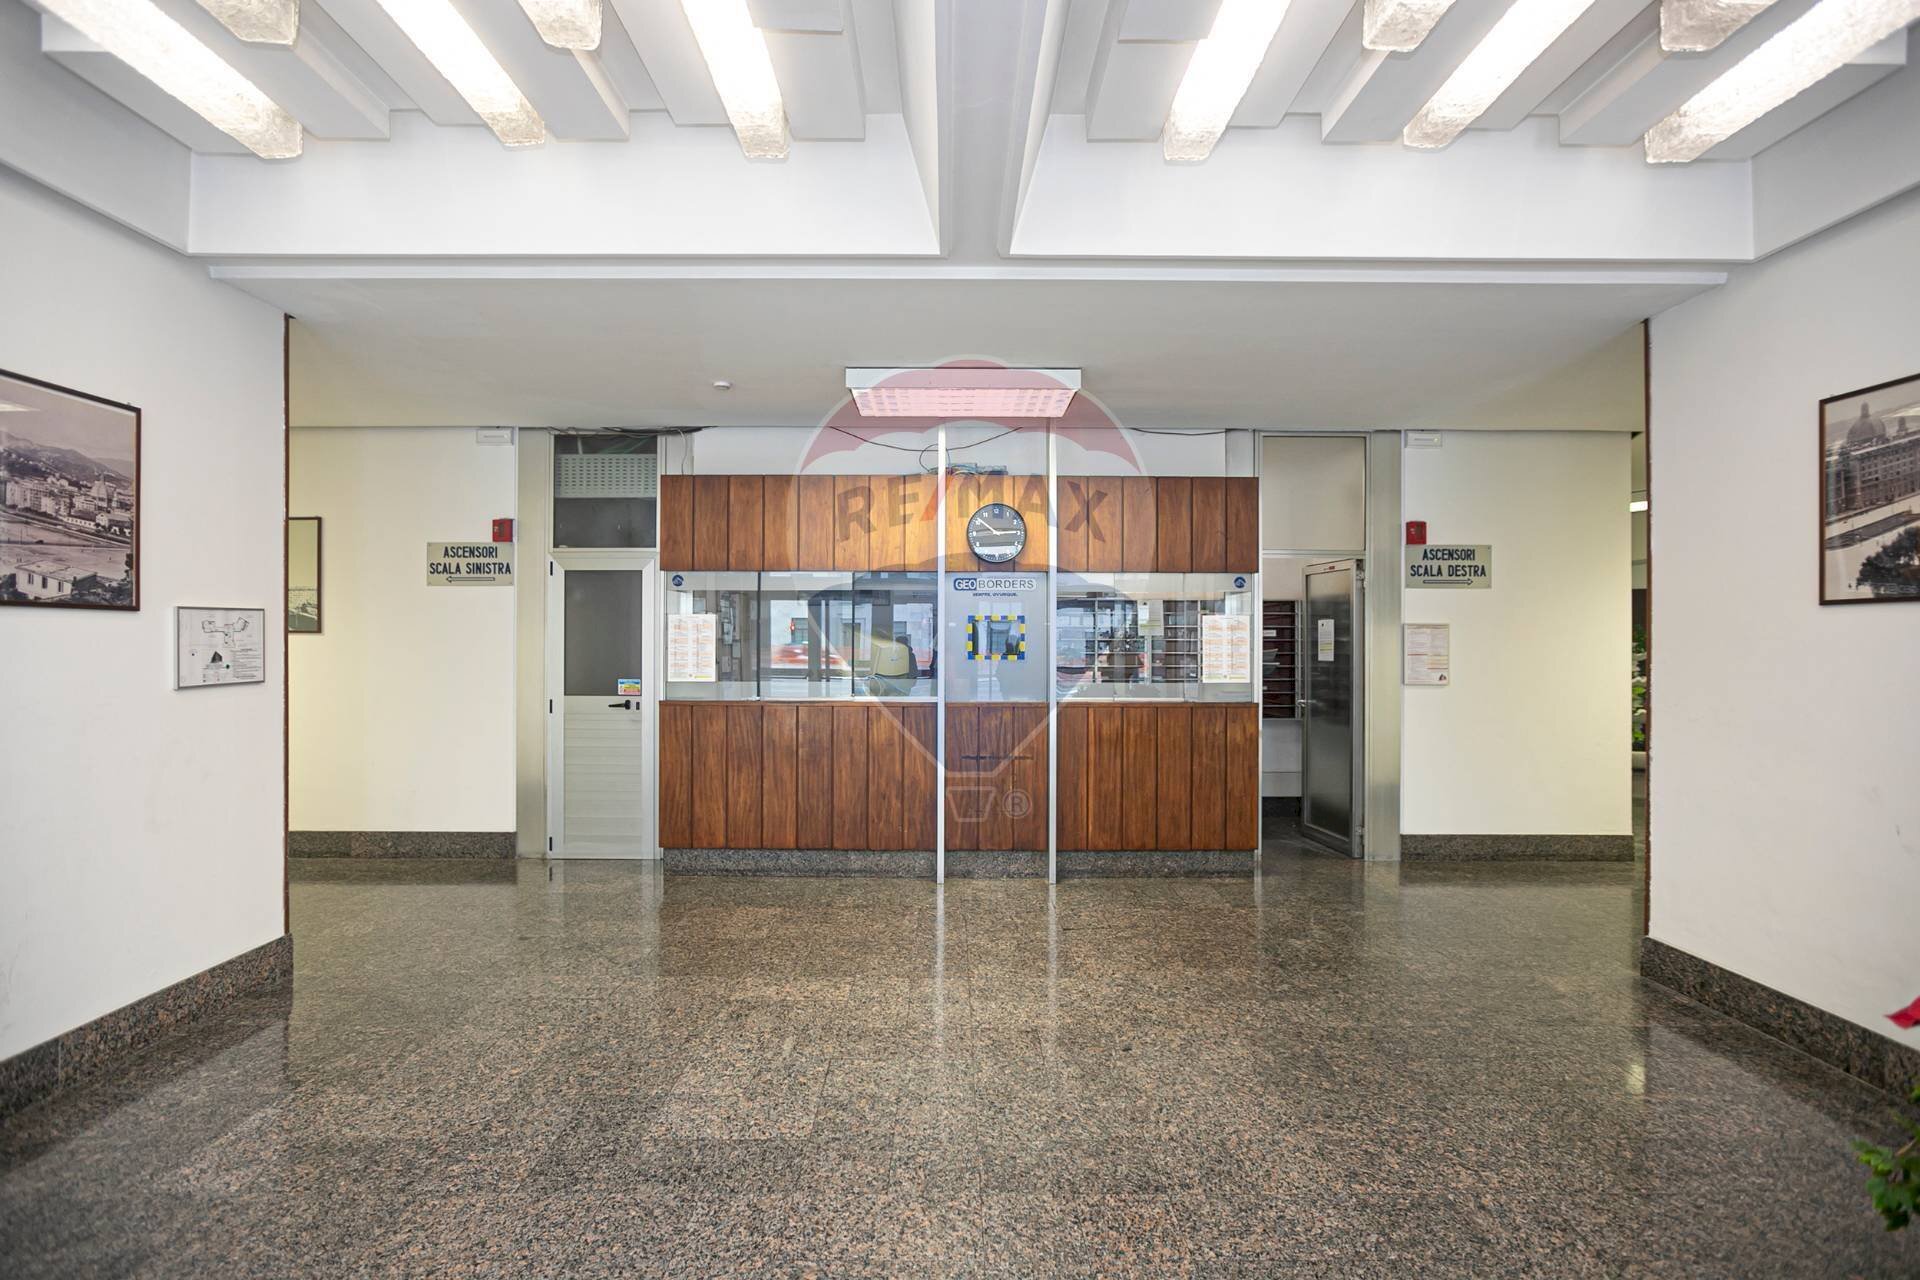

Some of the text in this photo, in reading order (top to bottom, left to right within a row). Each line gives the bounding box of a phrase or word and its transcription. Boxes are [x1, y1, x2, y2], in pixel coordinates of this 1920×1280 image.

[443, 546, 498, 558] ASCENSORI
[1422, 549, 1476, 561] ASCENSORI
[429, 562, 512, 575] SCALA SINISTRA
[1410, 565, 1487, 577] SCALA DESTRA
[954, 578, 1035, 591] GEOBORDERS
